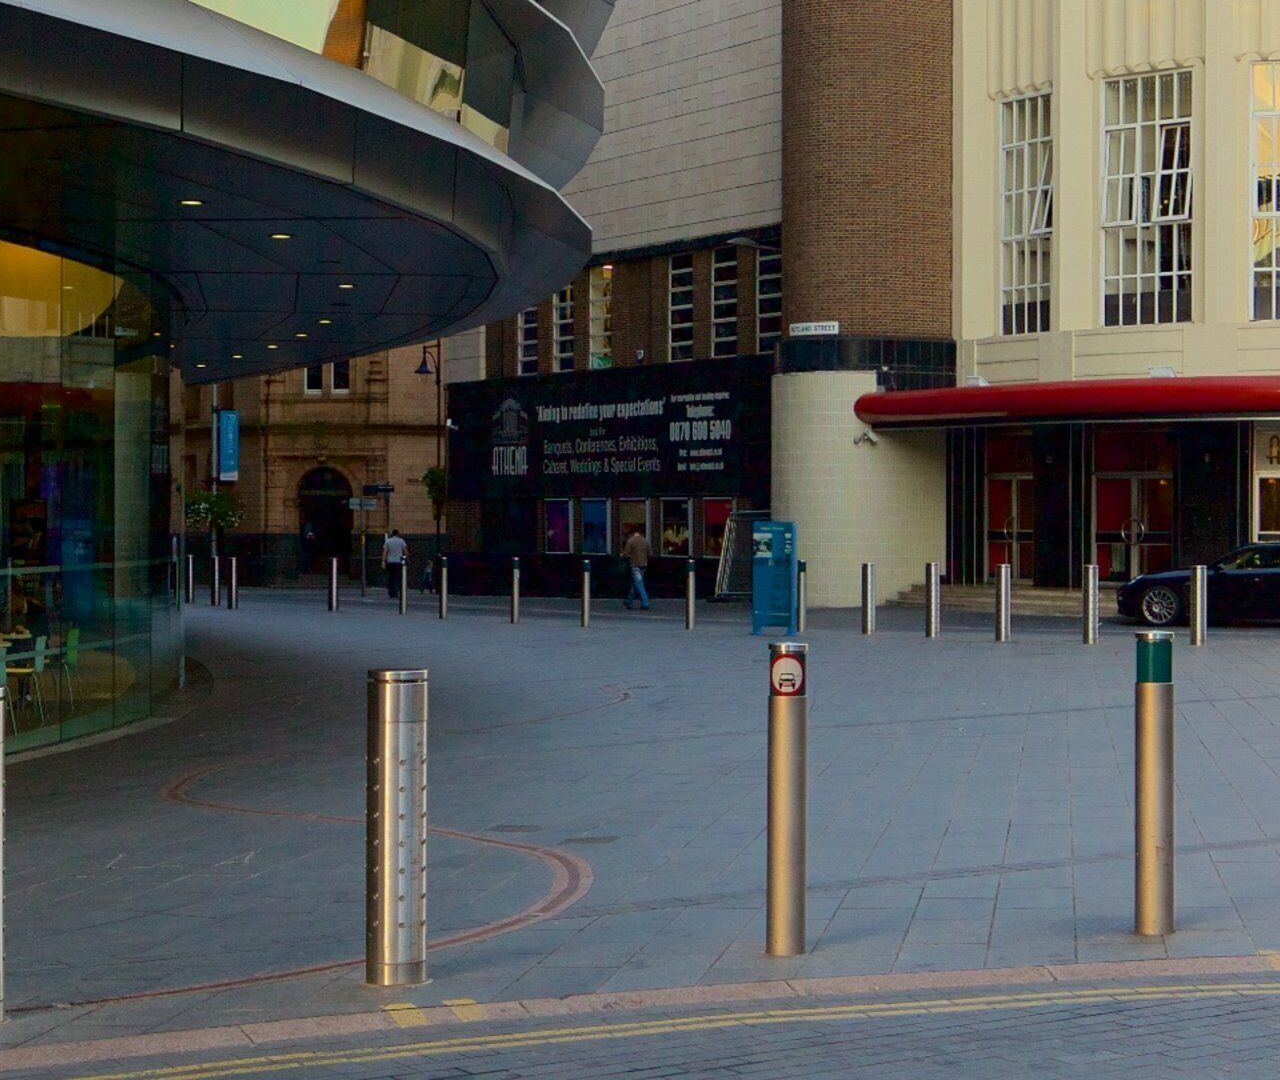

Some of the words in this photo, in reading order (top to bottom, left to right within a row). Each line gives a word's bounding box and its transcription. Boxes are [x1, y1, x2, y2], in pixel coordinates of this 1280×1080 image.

[813, 324, 836, 332] STREET
[569, 402, 599, 420] redefine
[599, 404, 616, 422] your
[669, 421, 691, 442] 0870
[692, 421, 708, 441] 600
[492, 445, 529, 475] ATHENA
[570, 457, 603, 476] Weddings
[603, 457, 609, 473] &
[610, 456, 636, 475] Special
[637, 456, 662, 472] Events
